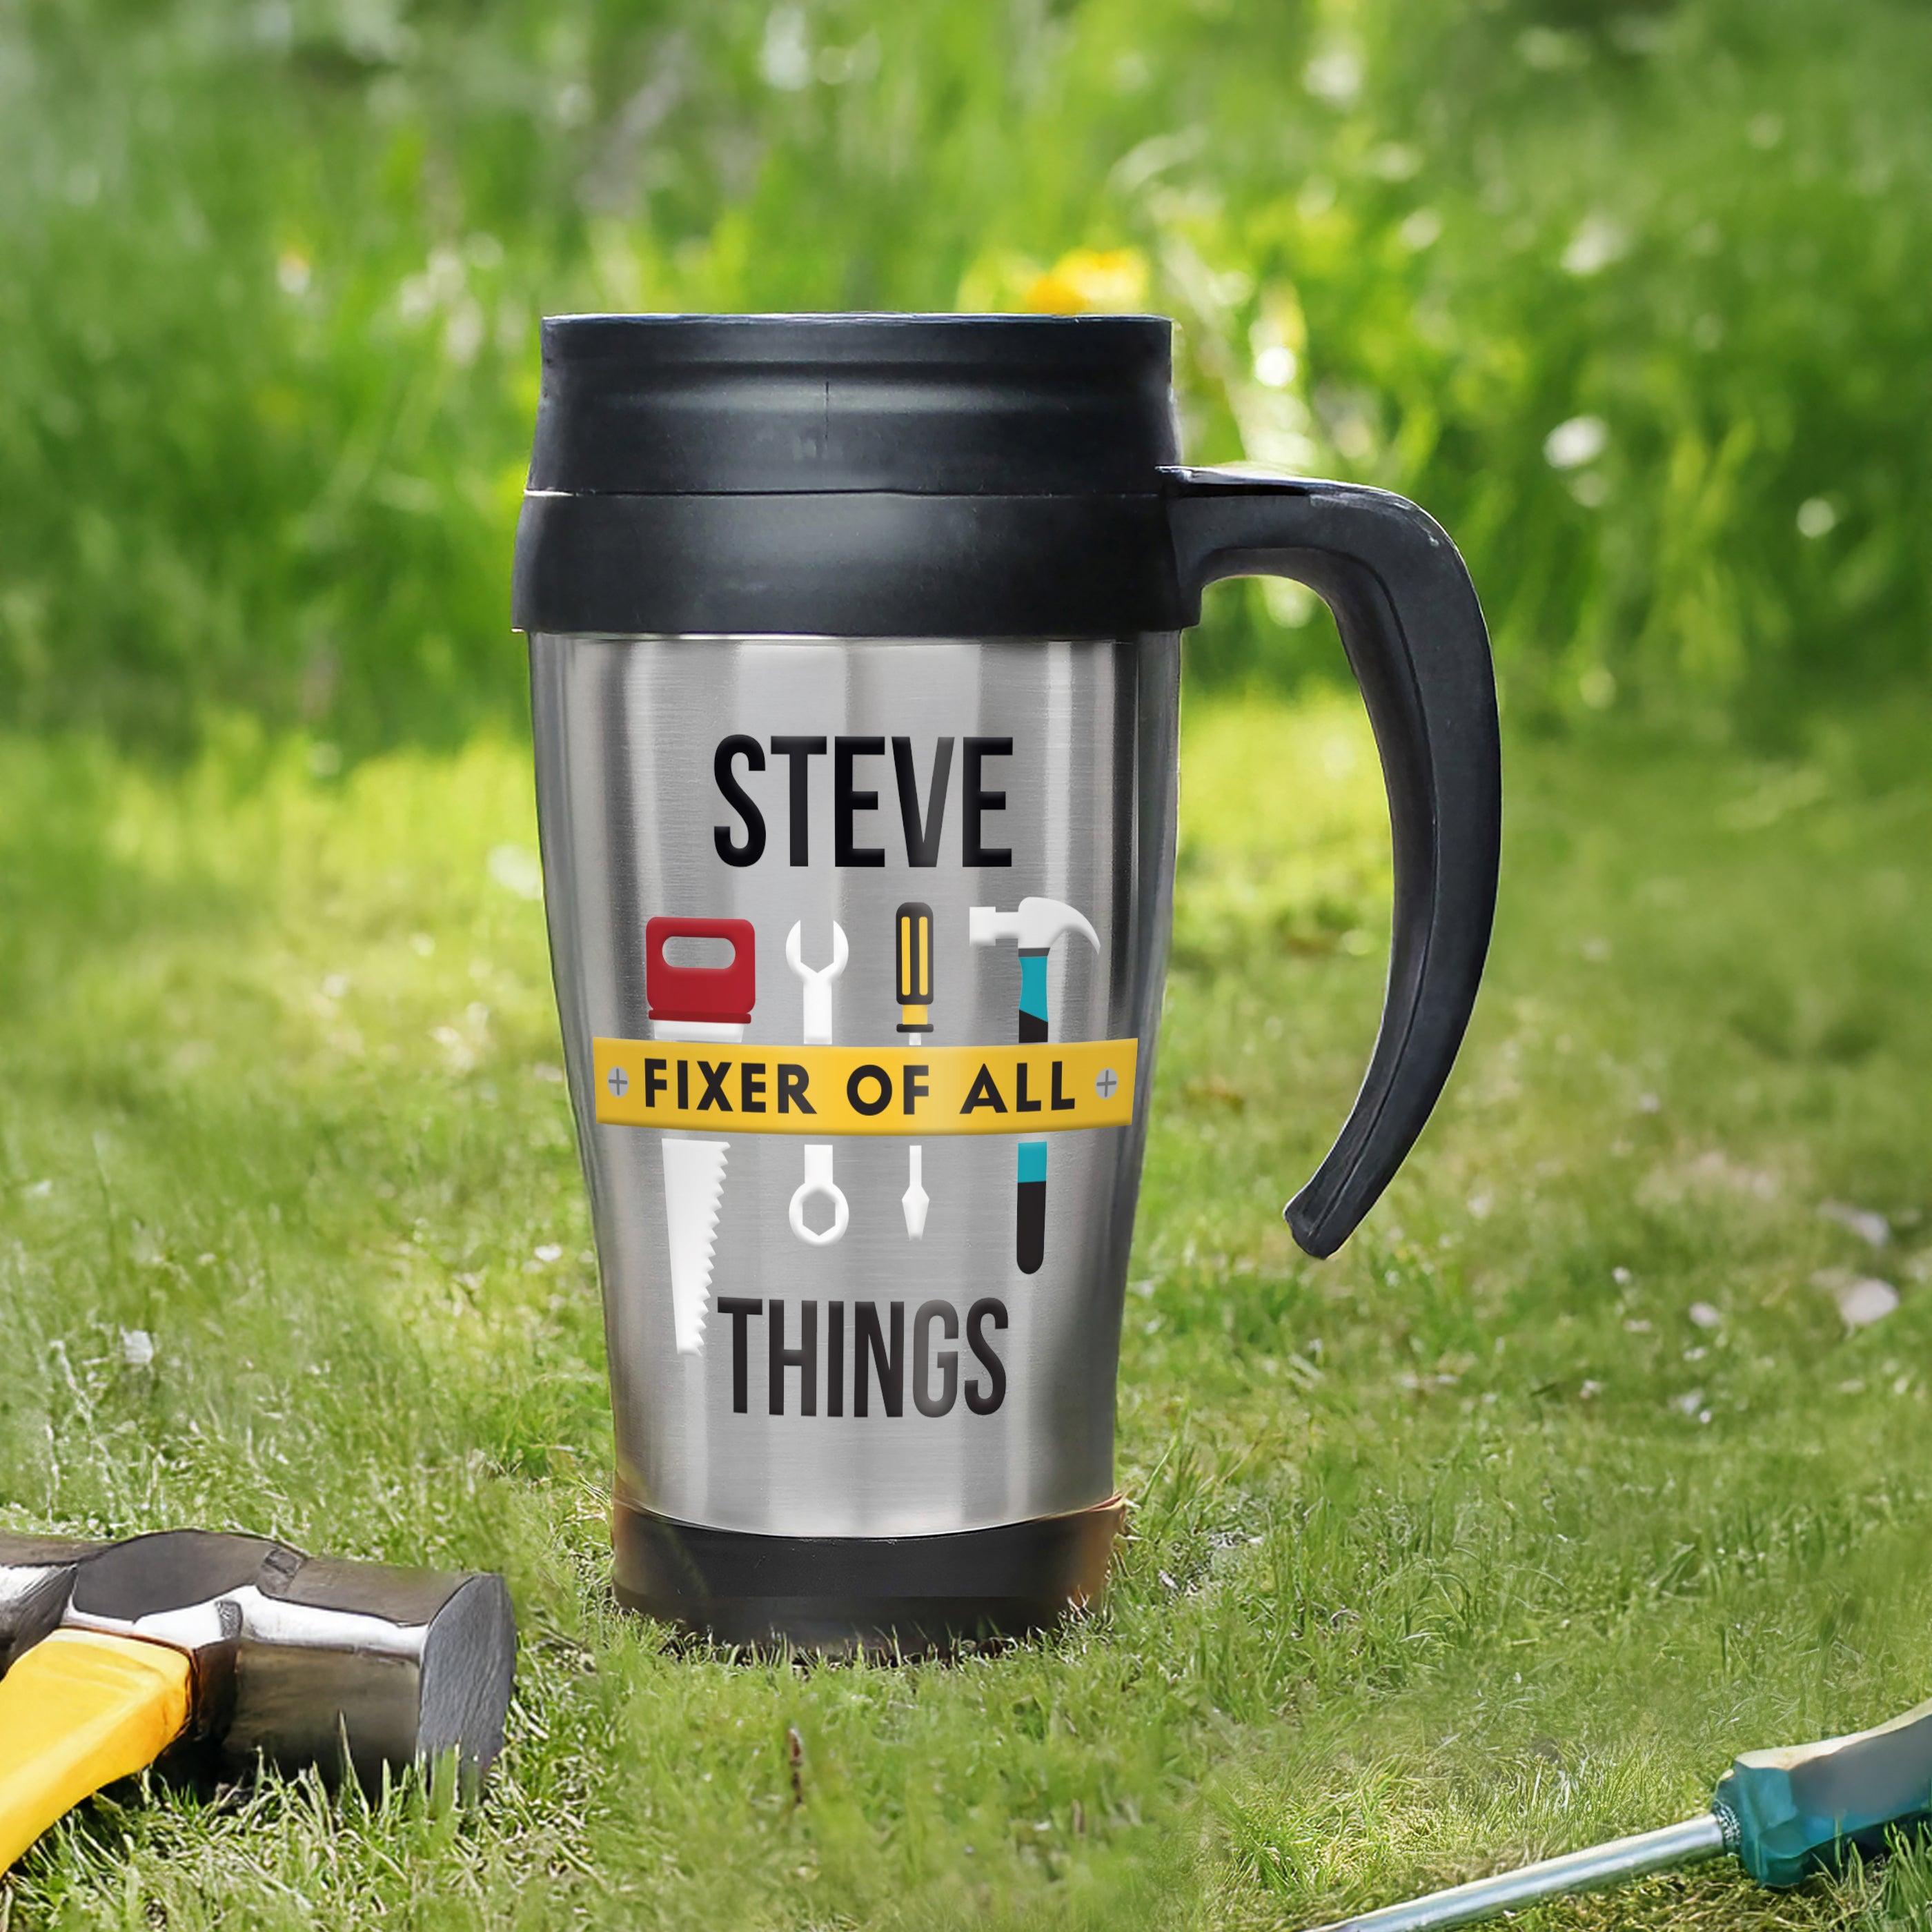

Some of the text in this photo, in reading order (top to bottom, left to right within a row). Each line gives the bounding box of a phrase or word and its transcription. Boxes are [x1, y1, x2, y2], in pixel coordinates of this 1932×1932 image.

[714, 734, 1013, 868] STEVE
[644, 1058, 1075, 1116] FIXER OF ALL
[718, 1297, 1008, 1418] THINGS
